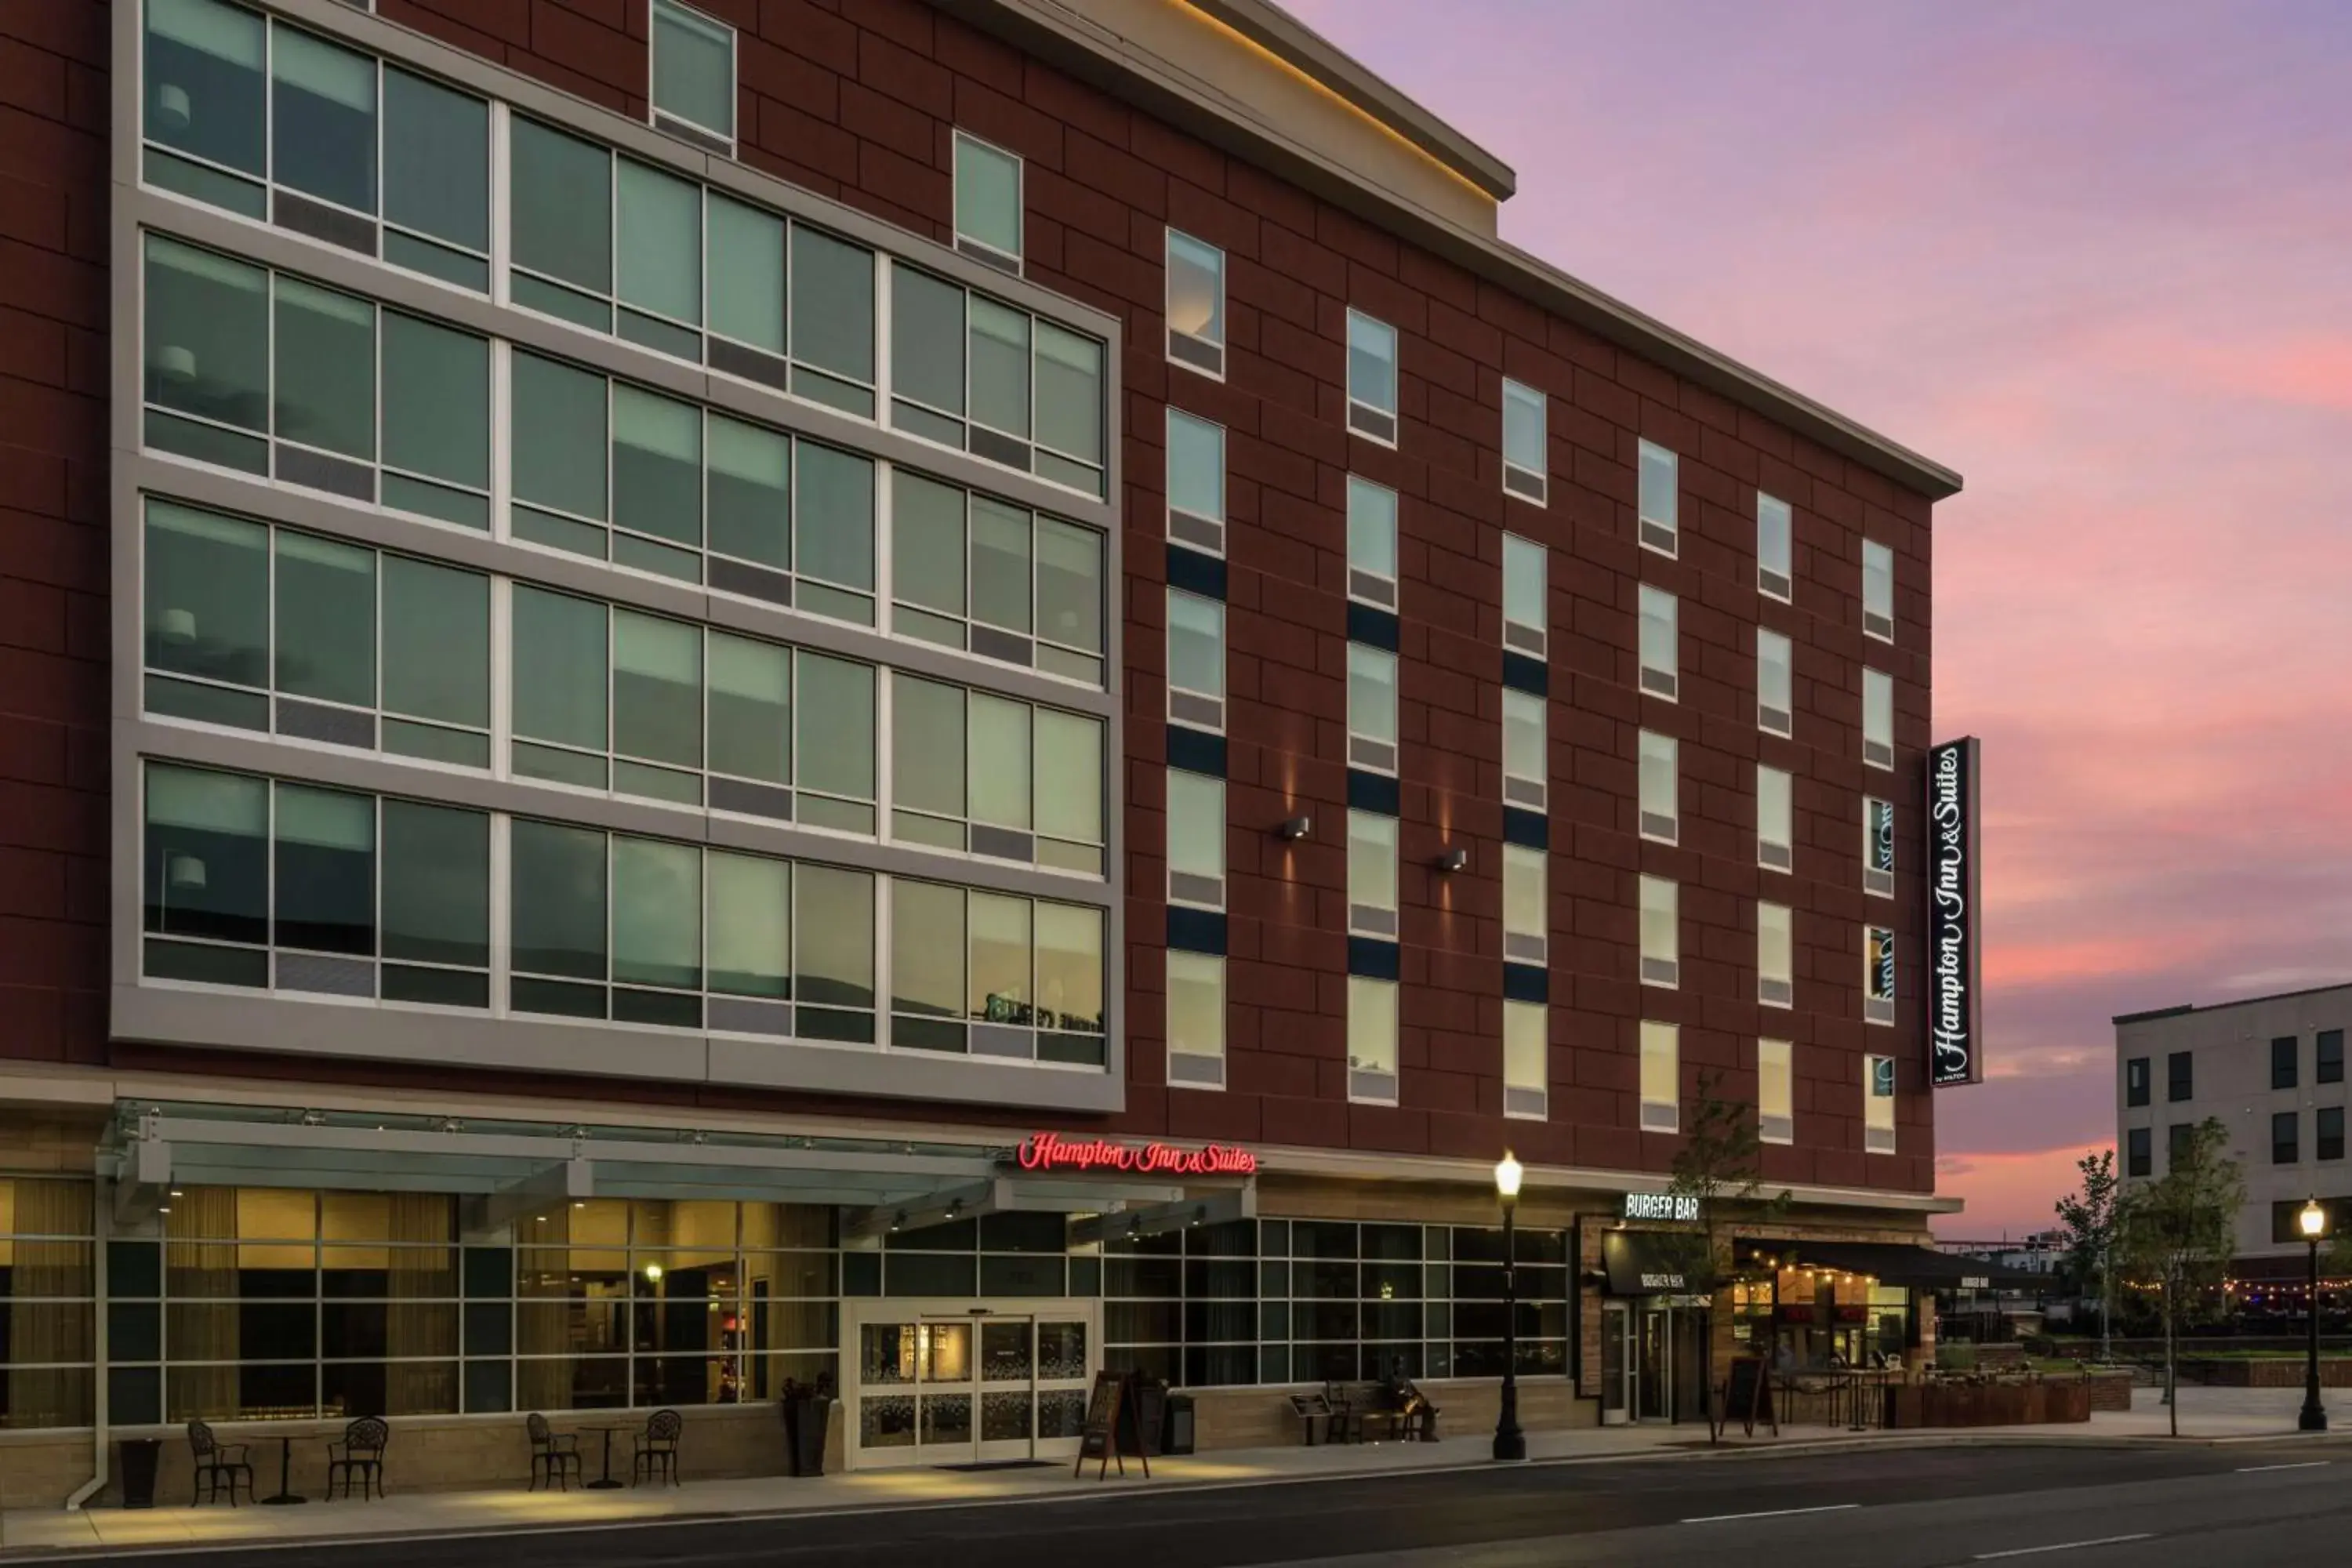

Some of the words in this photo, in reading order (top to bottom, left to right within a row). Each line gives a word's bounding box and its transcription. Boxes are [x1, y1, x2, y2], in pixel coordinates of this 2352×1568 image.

[1933, 747, 1959, 828] Suites
[1934, 846, 1963, 920] Inn
[1933, 924, 1967, 1072] Hampton
[1018, 1132, 1134, 1170] Hampton
[1136, 1142, 1189, 1173] Inn
[1201, 1144, 1255, 1174] Suites
[1626, 1194, 1673, 1220] BURGER
[1675, 1197, 1699, 1221] BAR
